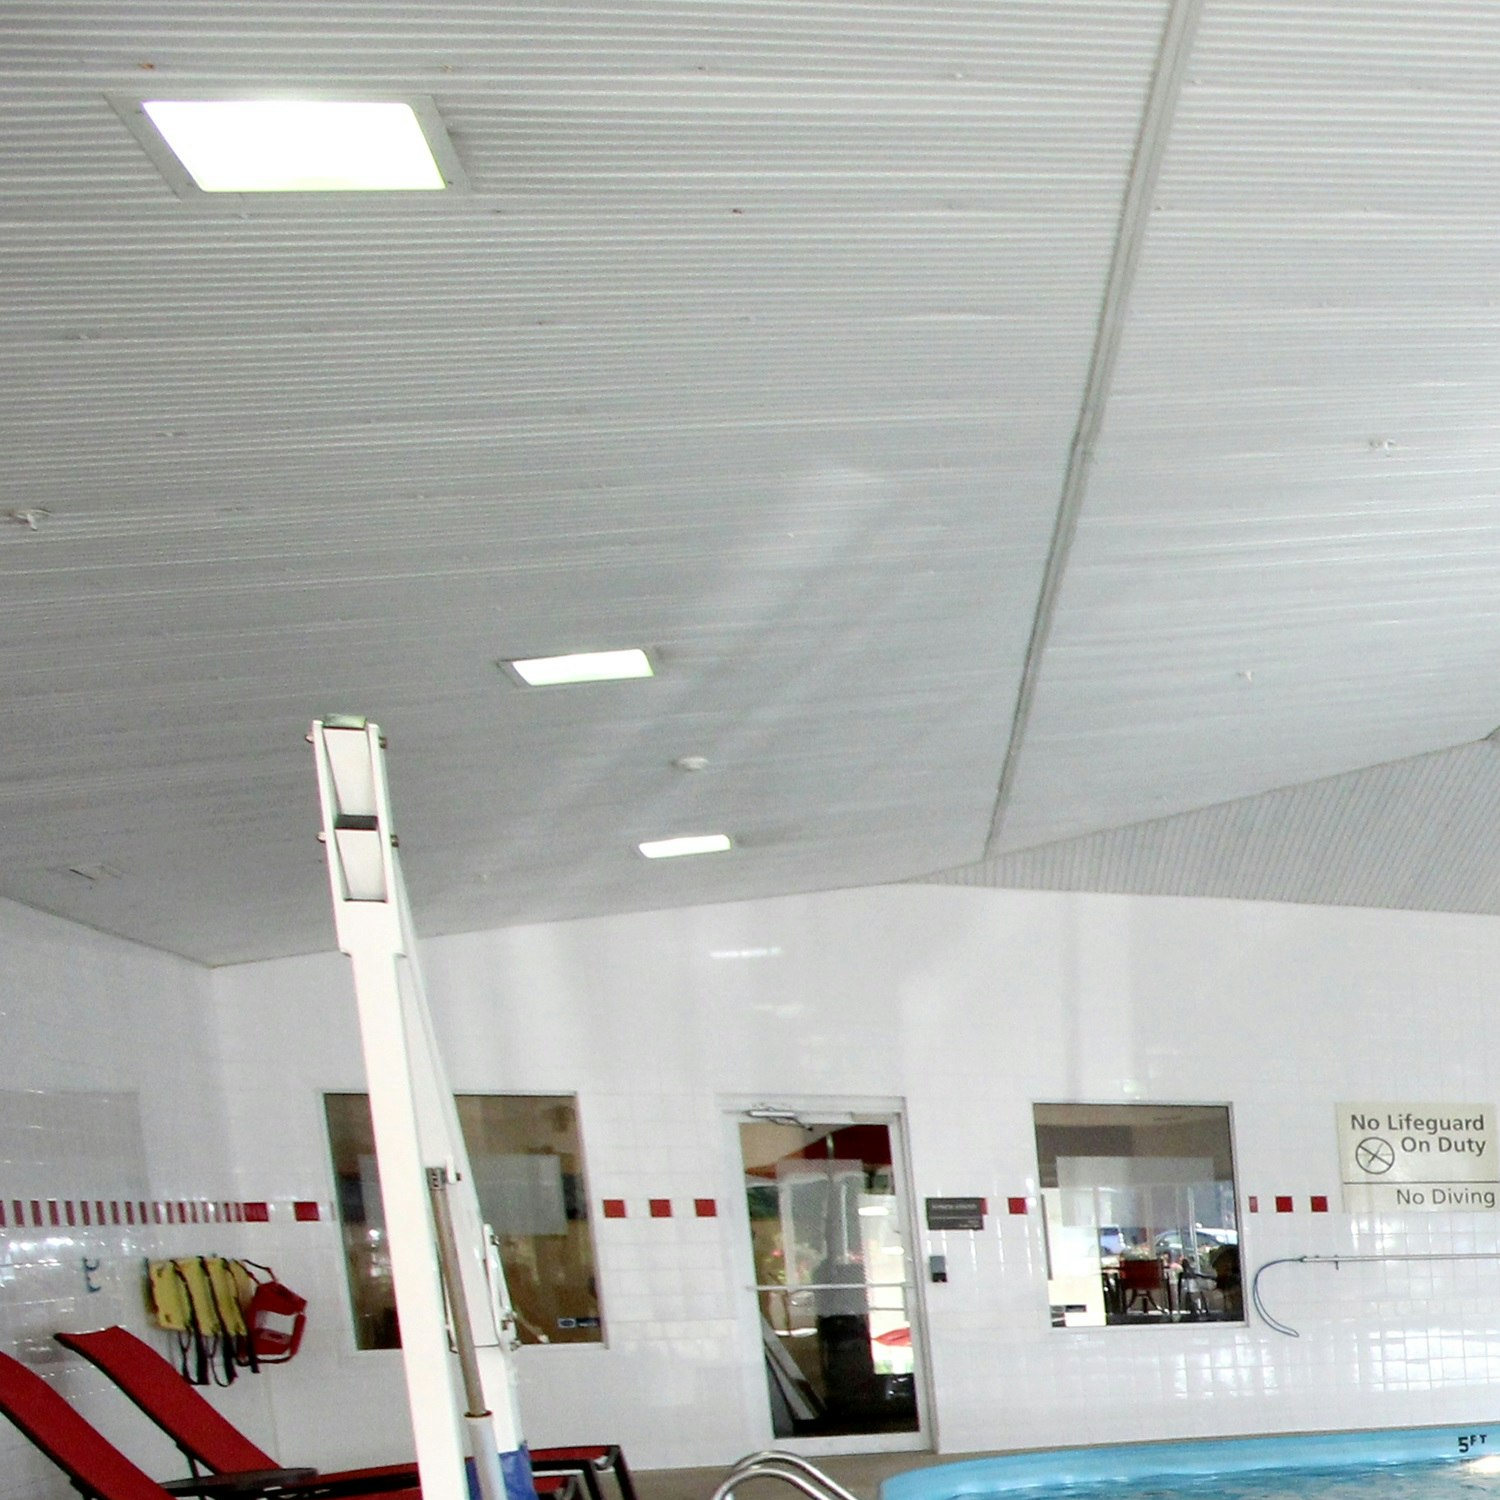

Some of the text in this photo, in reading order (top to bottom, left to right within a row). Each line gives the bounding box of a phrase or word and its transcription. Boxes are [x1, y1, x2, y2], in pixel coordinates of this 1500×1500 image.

[1351, 1114, 1484, 1135] No Lifeguard
[1401, 1137, 1486, 1157] On Duty
[1397, 1188, 1495, 1208] No Diving
